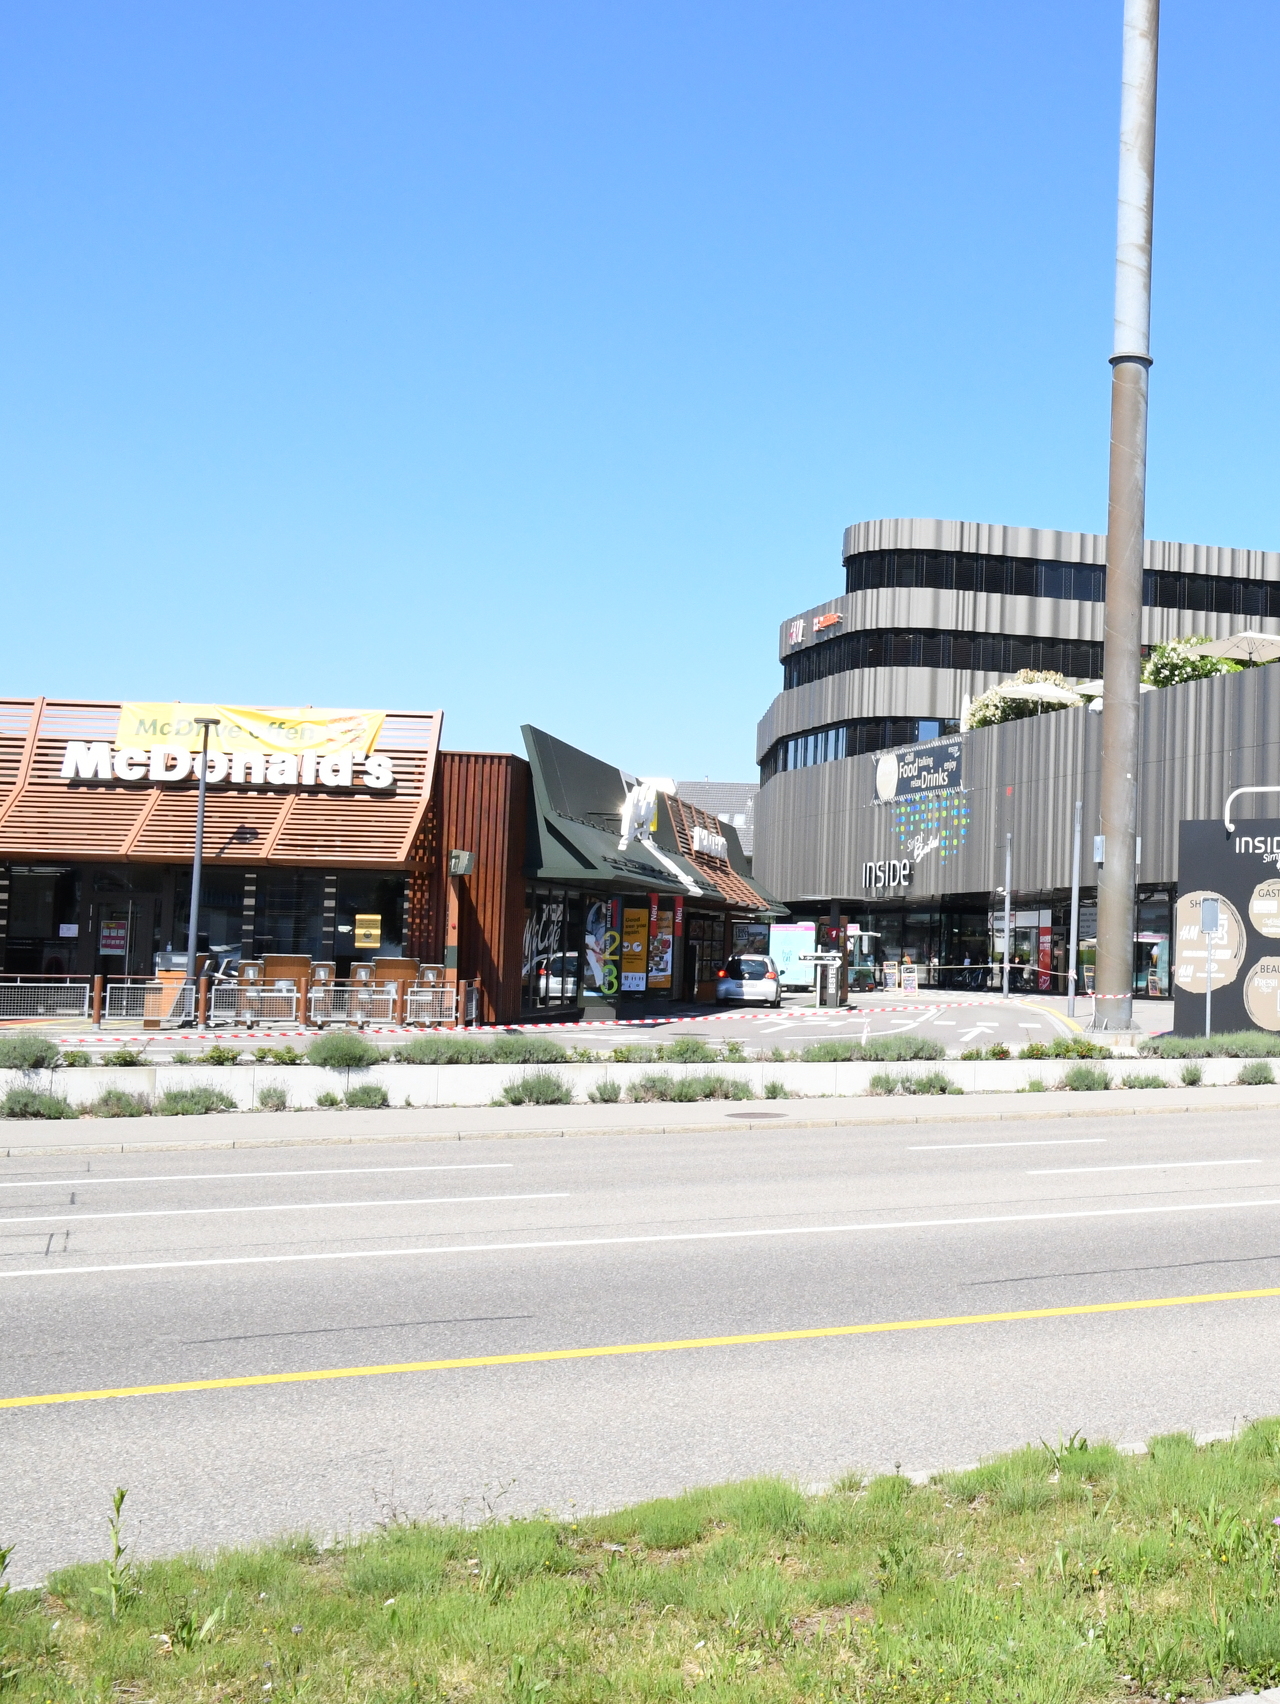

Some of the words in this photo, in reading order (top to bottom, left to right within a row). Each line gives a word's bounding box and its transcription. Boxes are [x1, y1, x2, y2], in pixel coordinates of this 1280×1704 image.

[135, 716, 242, 739] McDrve
[60, 740, 395, 788] McDonald's
[899, 758, 918, 778] Food
[944, 760, 957, 771] enjoy
[921, 768, 948, 788] Drinks
[650, 905, 658, 921] Neu
[675, 907, 683, 923] Neu
[1180, 925, 1200, 941] H&M
